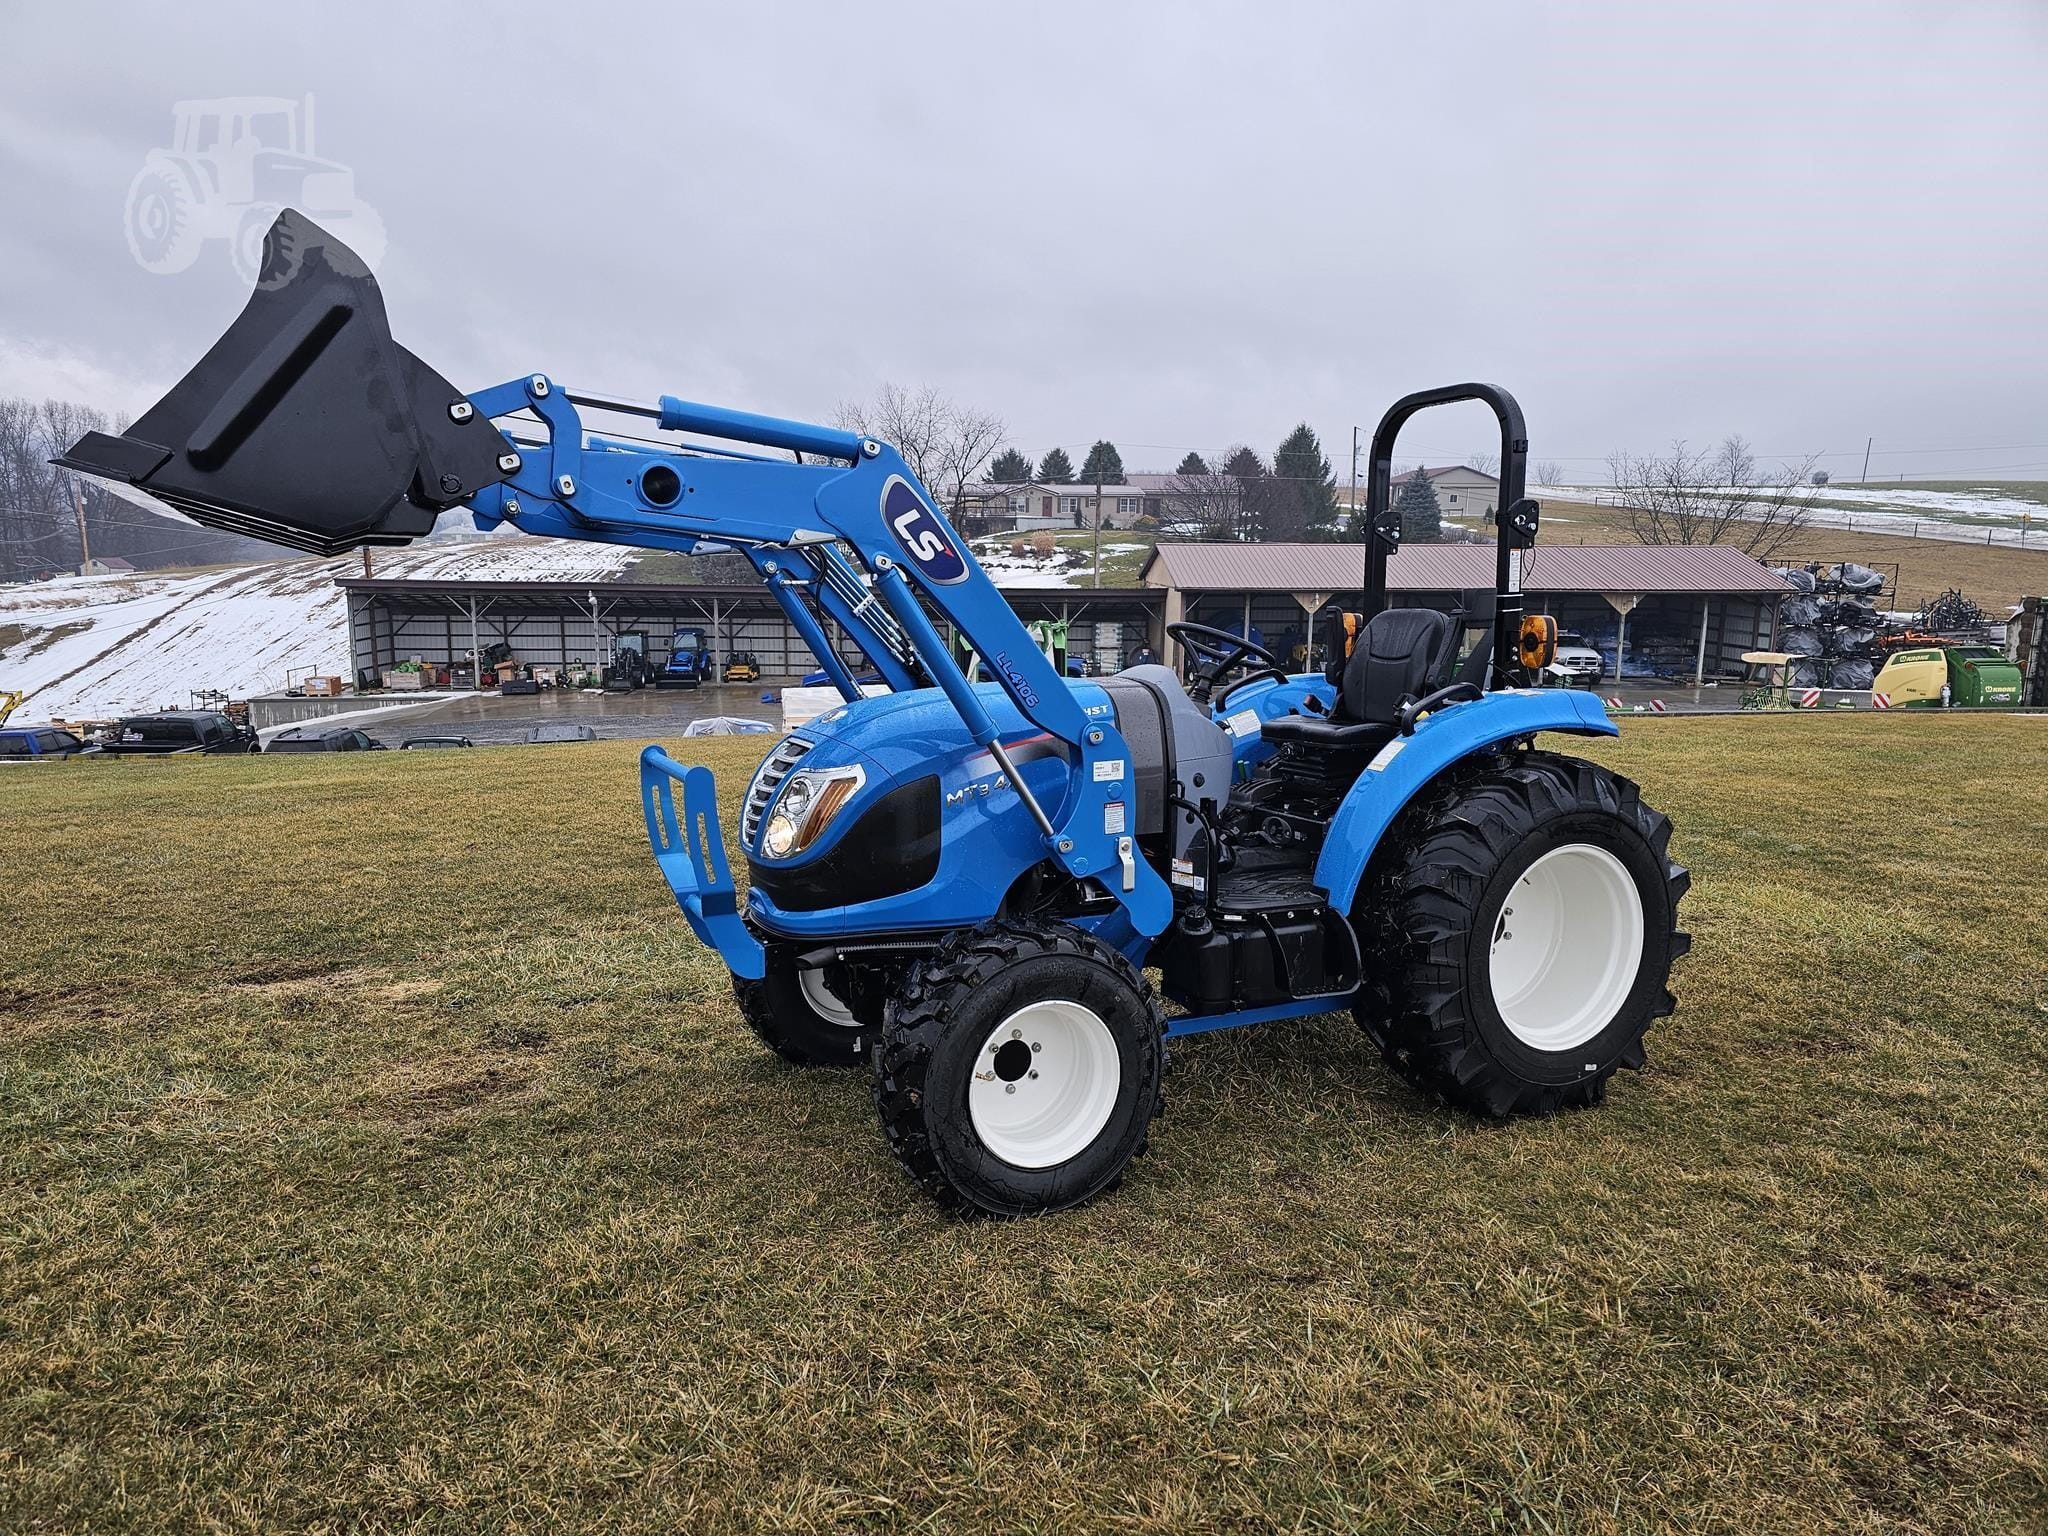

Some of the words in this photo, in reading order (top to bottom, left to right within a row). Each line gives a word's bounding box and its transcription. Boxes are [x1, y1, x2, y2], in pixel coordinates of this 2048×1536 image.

[893, 508, 945, 561] LS
[996, 650, 1039, 708] LL4106
[1083, 704, 1109, 716] HST
